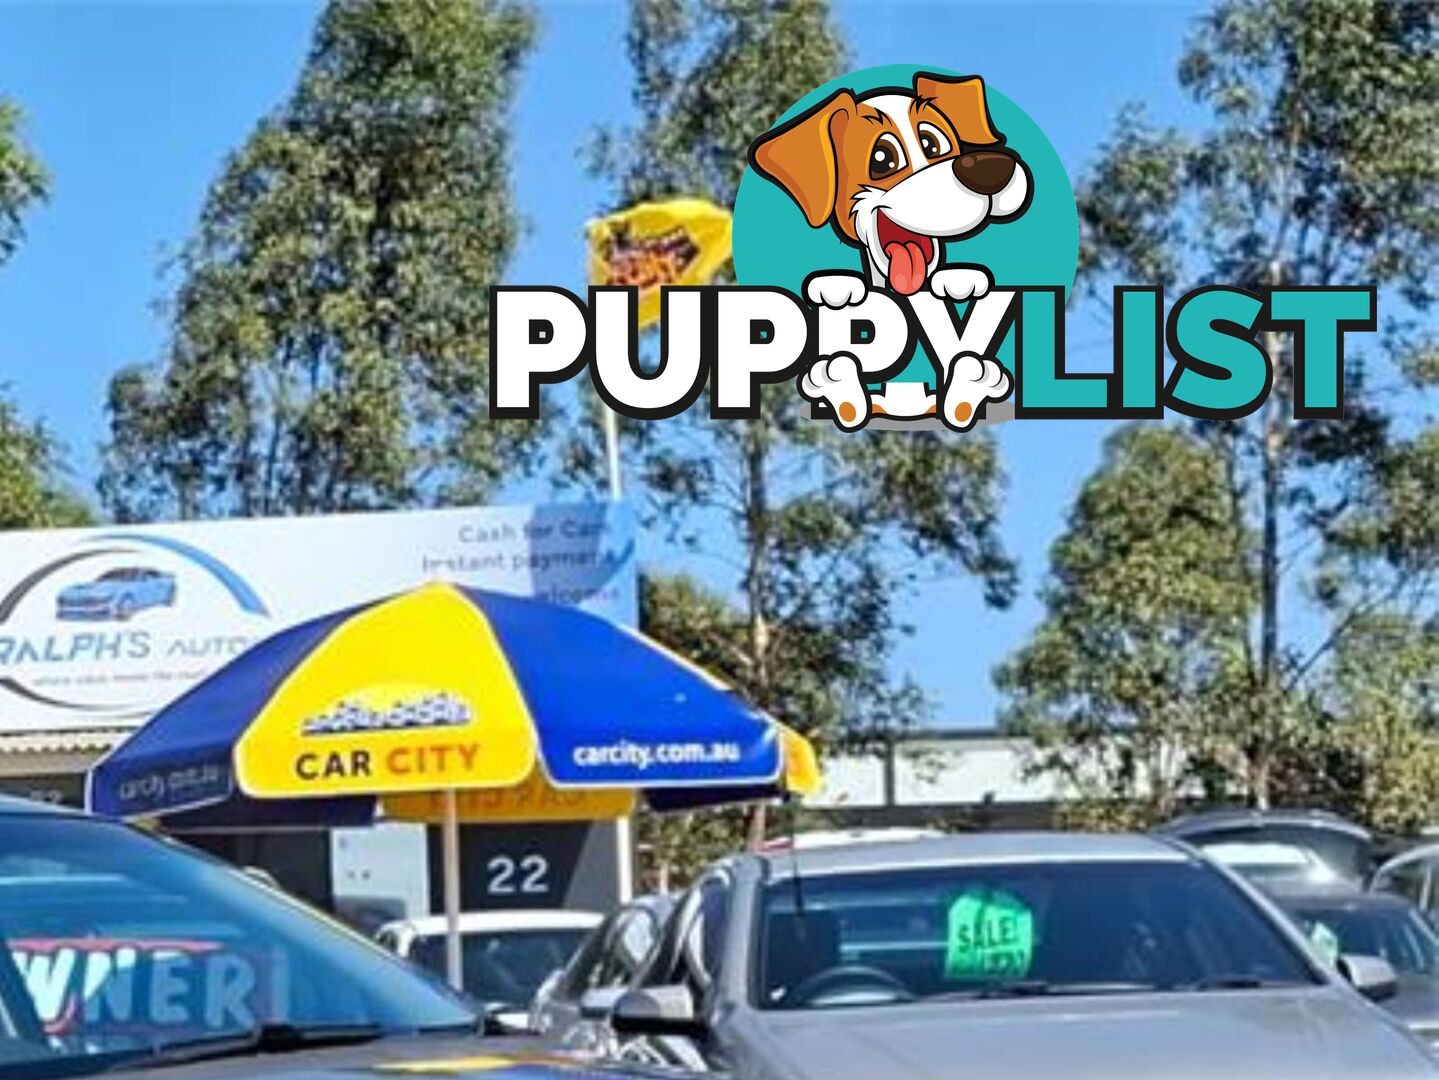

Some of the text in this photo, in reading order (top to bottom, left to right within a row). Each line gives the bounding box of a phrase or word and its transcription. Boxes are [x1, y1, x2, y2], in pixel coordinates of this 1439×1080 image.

[458, 523, 515, 543] Cash
[295, 742, 481, 781] CAR CITY
[572, 738, 741, 771] carcity.com.au
[486, 854, 550, 894] 22
